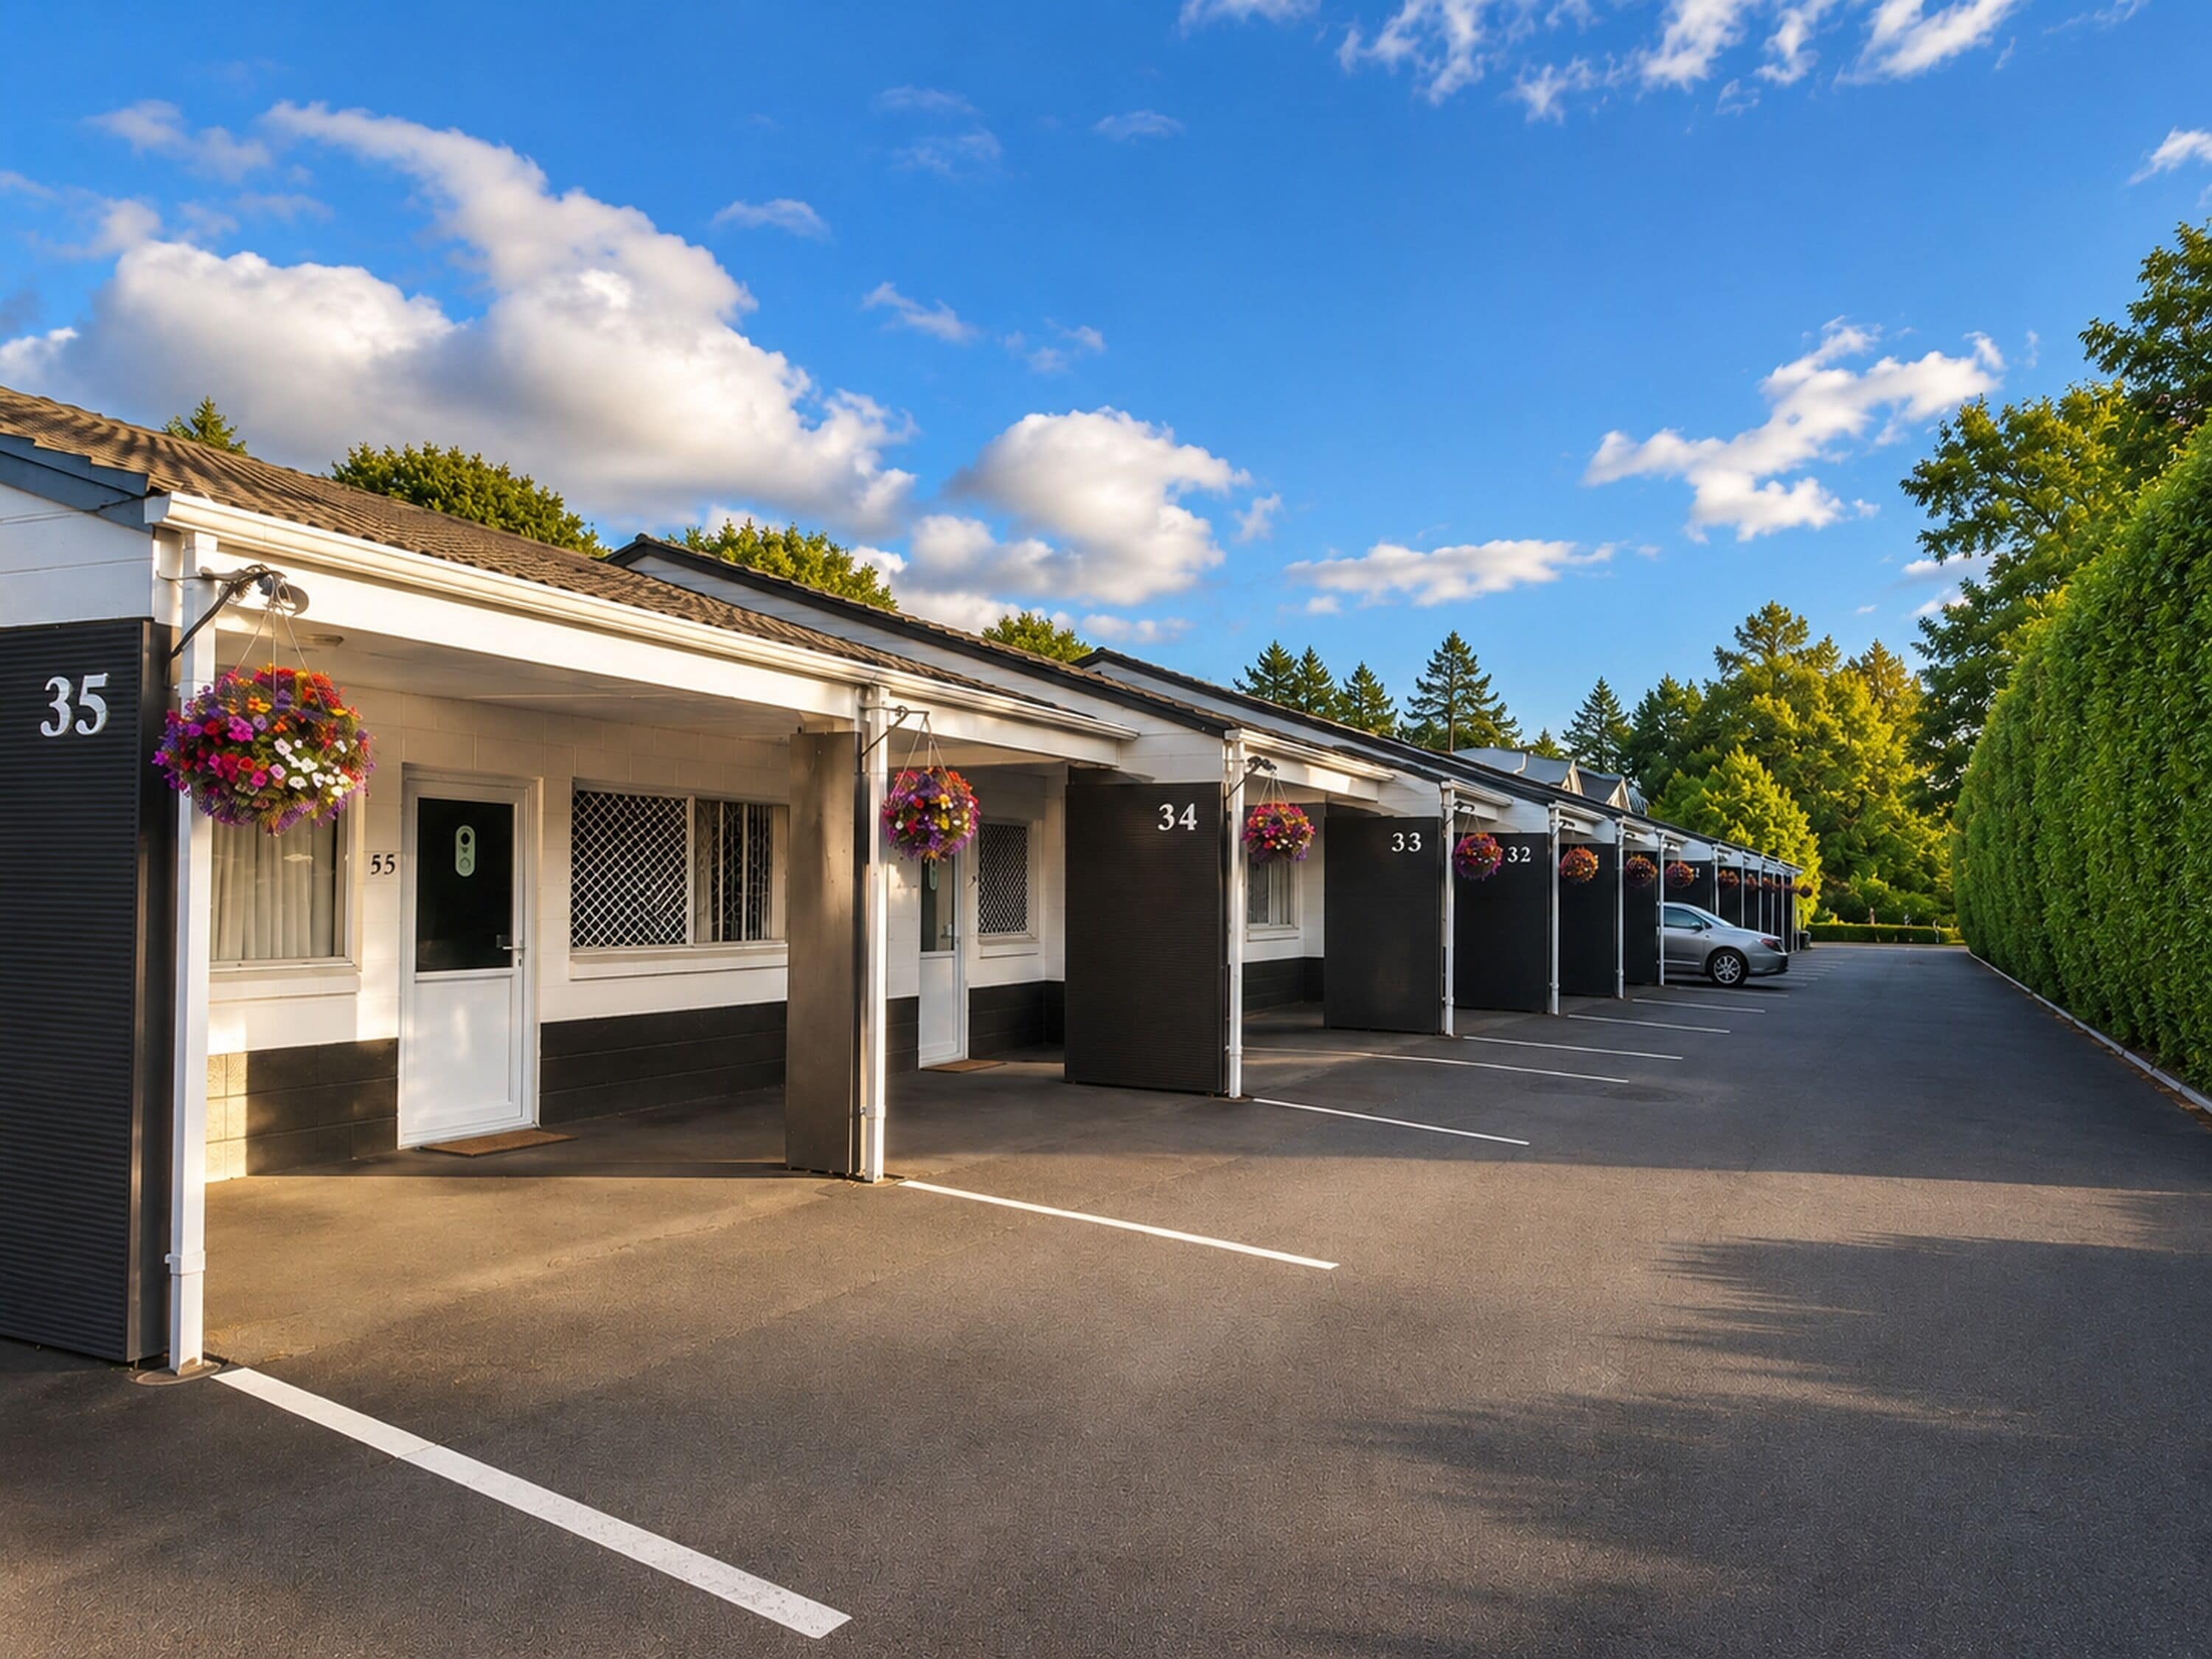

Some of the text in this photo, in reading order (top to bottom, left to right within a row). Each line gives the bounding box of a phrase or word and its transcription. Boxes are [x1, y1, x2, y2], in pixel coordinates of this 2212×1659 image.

[40, 672, 109, 737] 35
[1158, 802, 1197, 831] 34
[1391, 832, 1422, 852] 33
[371, 854, 395, 875] 55
[1507, 846, 1531, 863] 32
